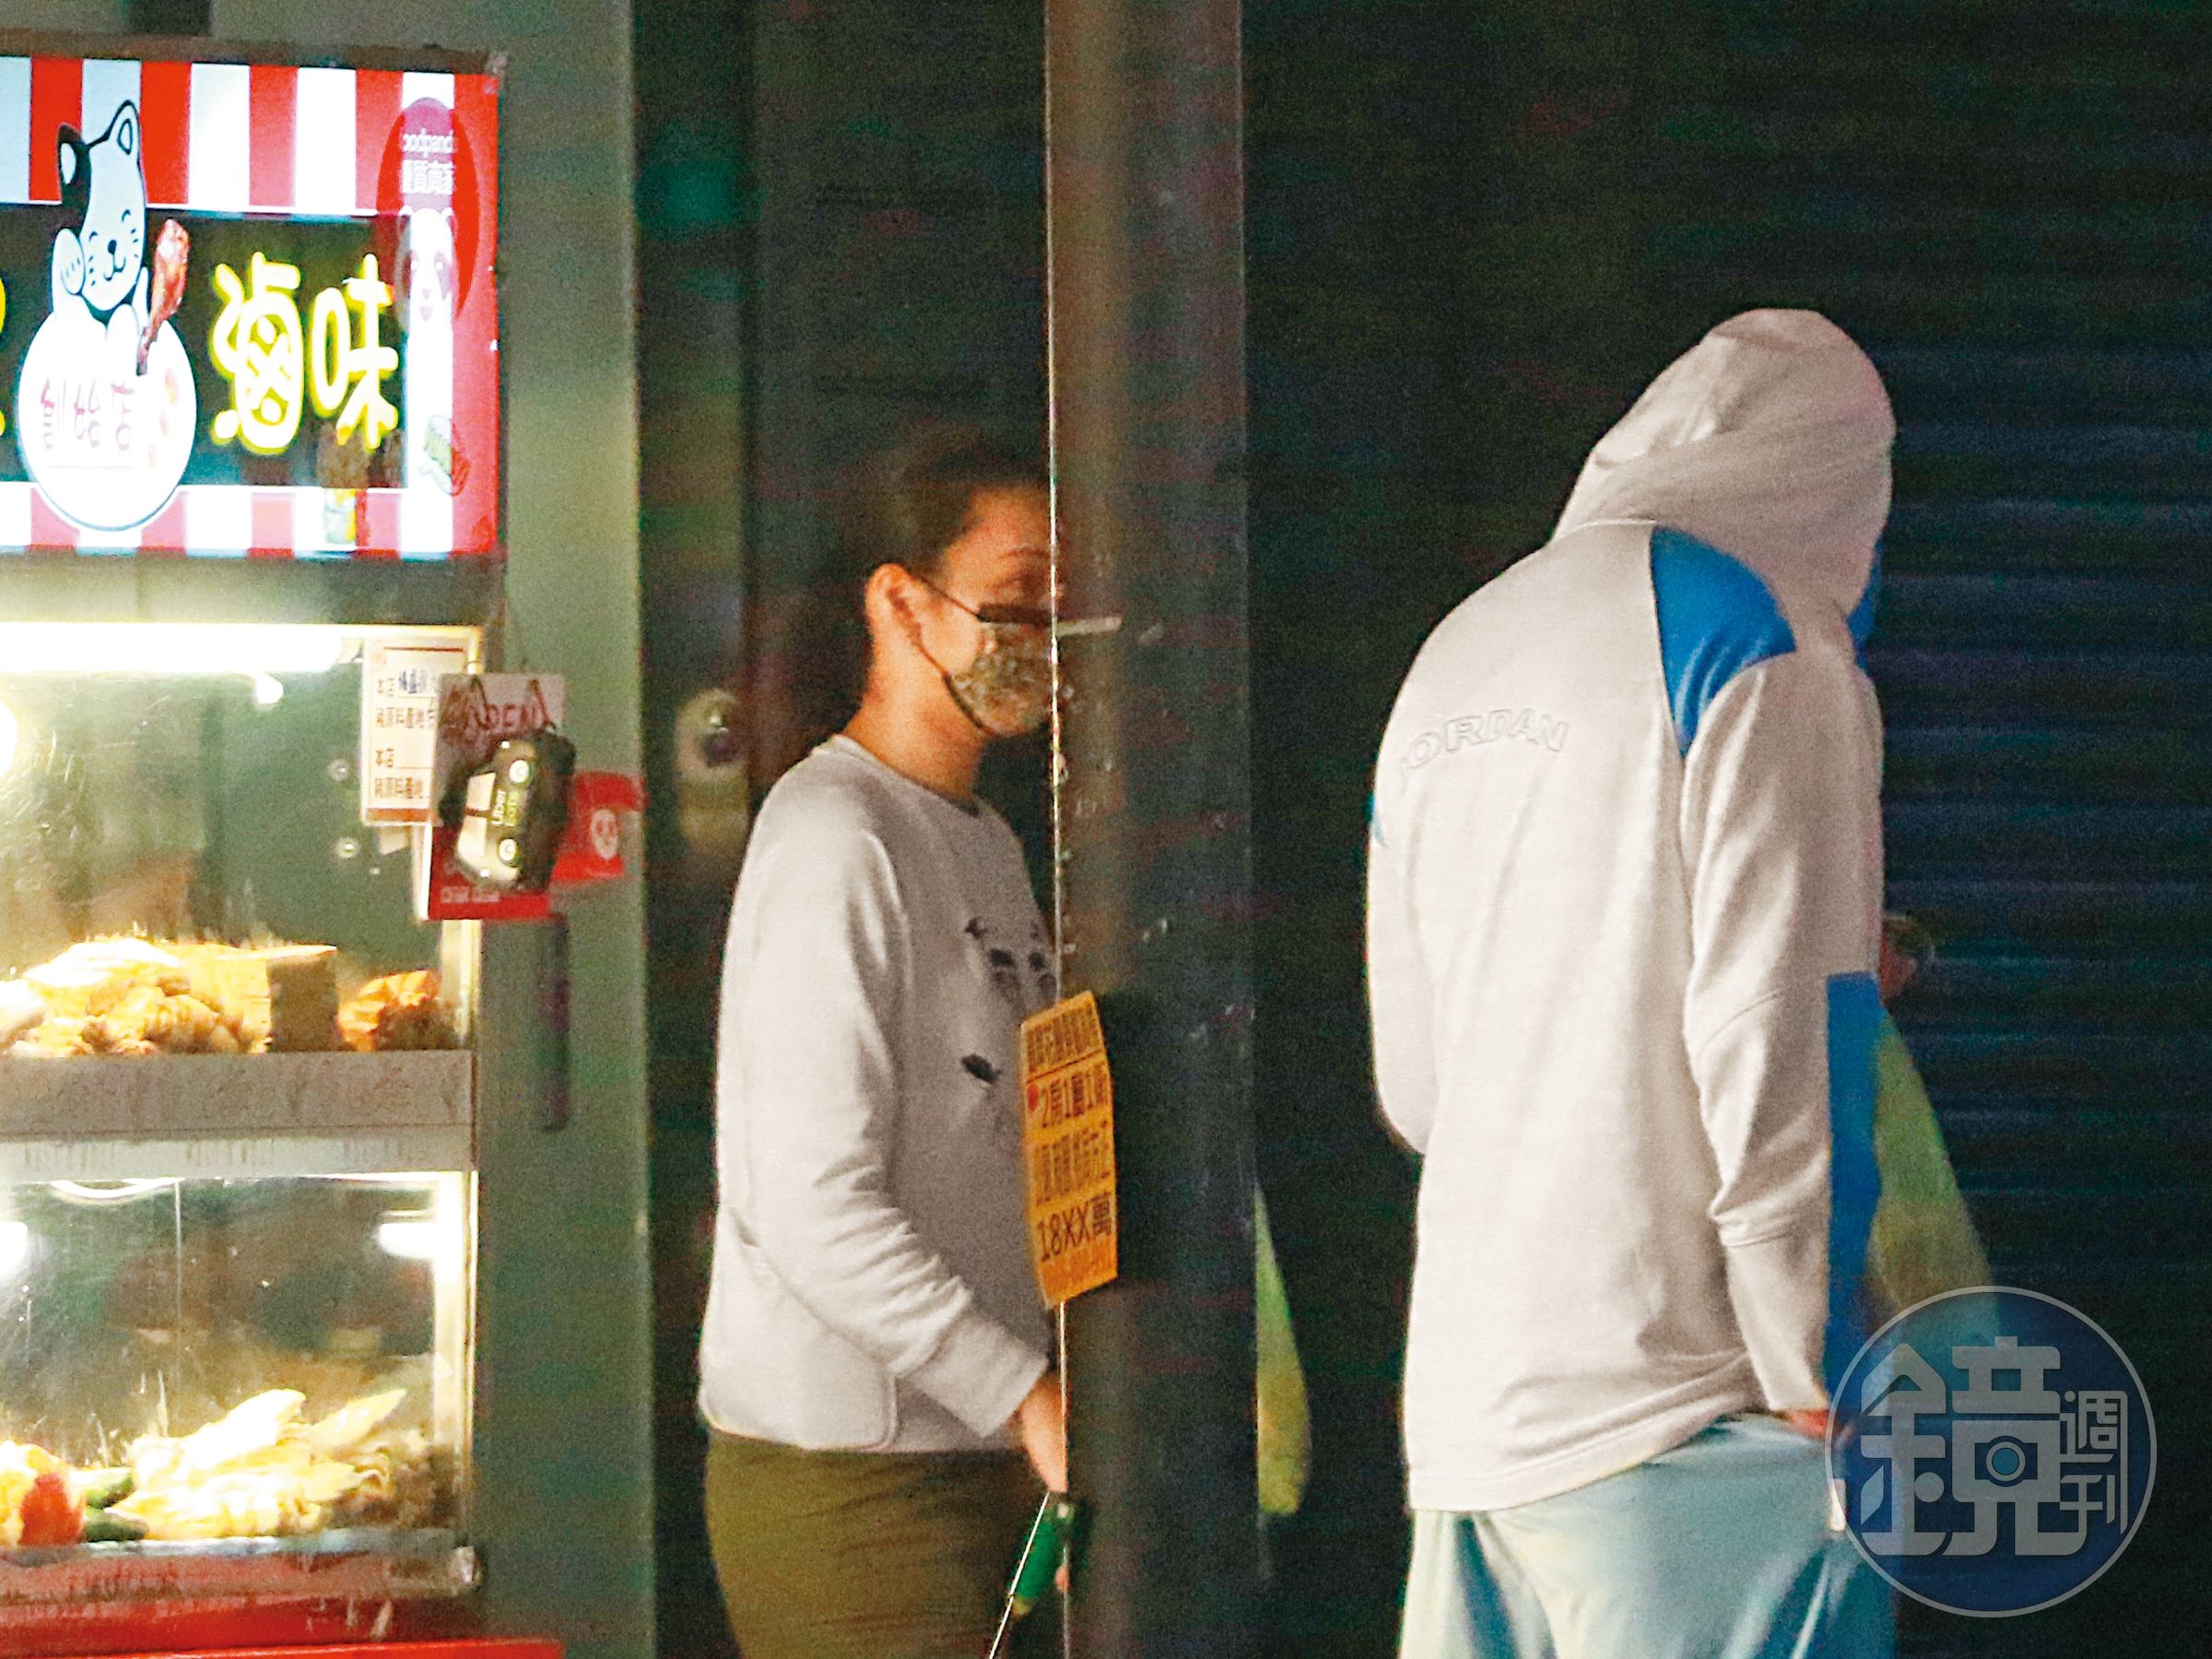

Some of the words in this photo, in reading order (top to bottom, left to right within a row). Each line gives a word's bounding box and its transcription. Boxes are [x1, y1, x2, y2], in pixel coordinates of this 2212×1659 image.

[212, 252, 399, 454] 滷味
[40, 377, 135, 450] 創始店
[491, 789, 506, 827] Uber
[1038, 1192, 1112, 1262] 18XX萬
